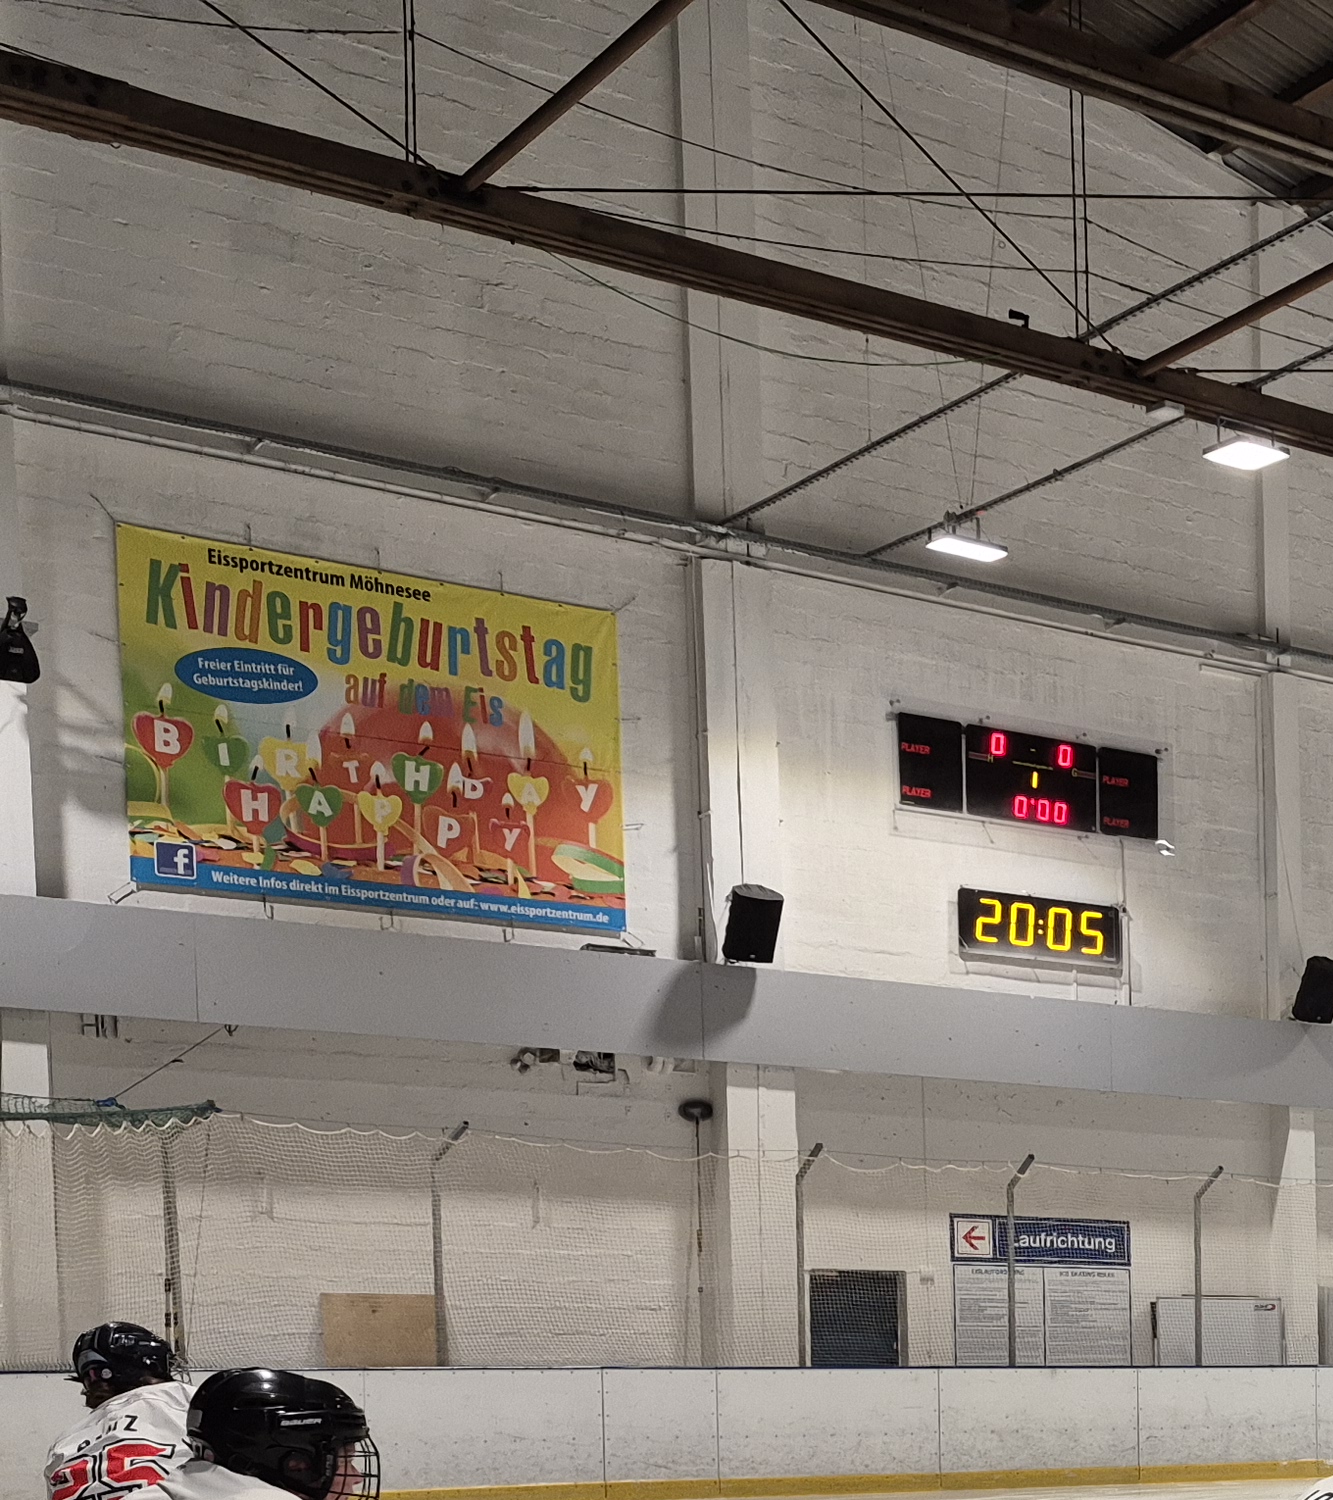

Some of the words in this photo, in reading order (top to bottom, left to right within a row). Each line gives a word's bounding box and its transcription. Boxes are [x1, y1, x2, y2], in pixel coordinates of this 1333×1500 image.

[208, 548, 345, 587] Eissportzentrum
[350, 573, 431, 602] Möhnesee
[145, 558, 593, 703] Kindergeburtstag
[197, 657, 231, 671] Freier
[234, 660, 276, 674] Eintritt
[277, 664, 294, 676] für
[193, 672, 303, 692] Geburtstagskinder!
[345, 673, 387, 708] auf
[398, 678, 455, 717] dem
[463, 686, 503, 726] Eis
[901, 742, 931, 755] PLAYER
[902, 785, 932, 798] PLAYER
[1102, 775, 1130, 788] PLAYER
[1103, 816, 1130, 829] PLAYER
[211, 870, 257, 887] Weitere
[259, 877, 288, 890] Infos
[289, 879, 323, 893] direkt
[324, 883, 339, 895] im
[341, 884, 430, 905] Eissportzentrum
[431, 894, 455, 907] oder
[480, 901, 610, 924] www.eissportzentrum.de
[975, 897, 1104, 956] 20:05
